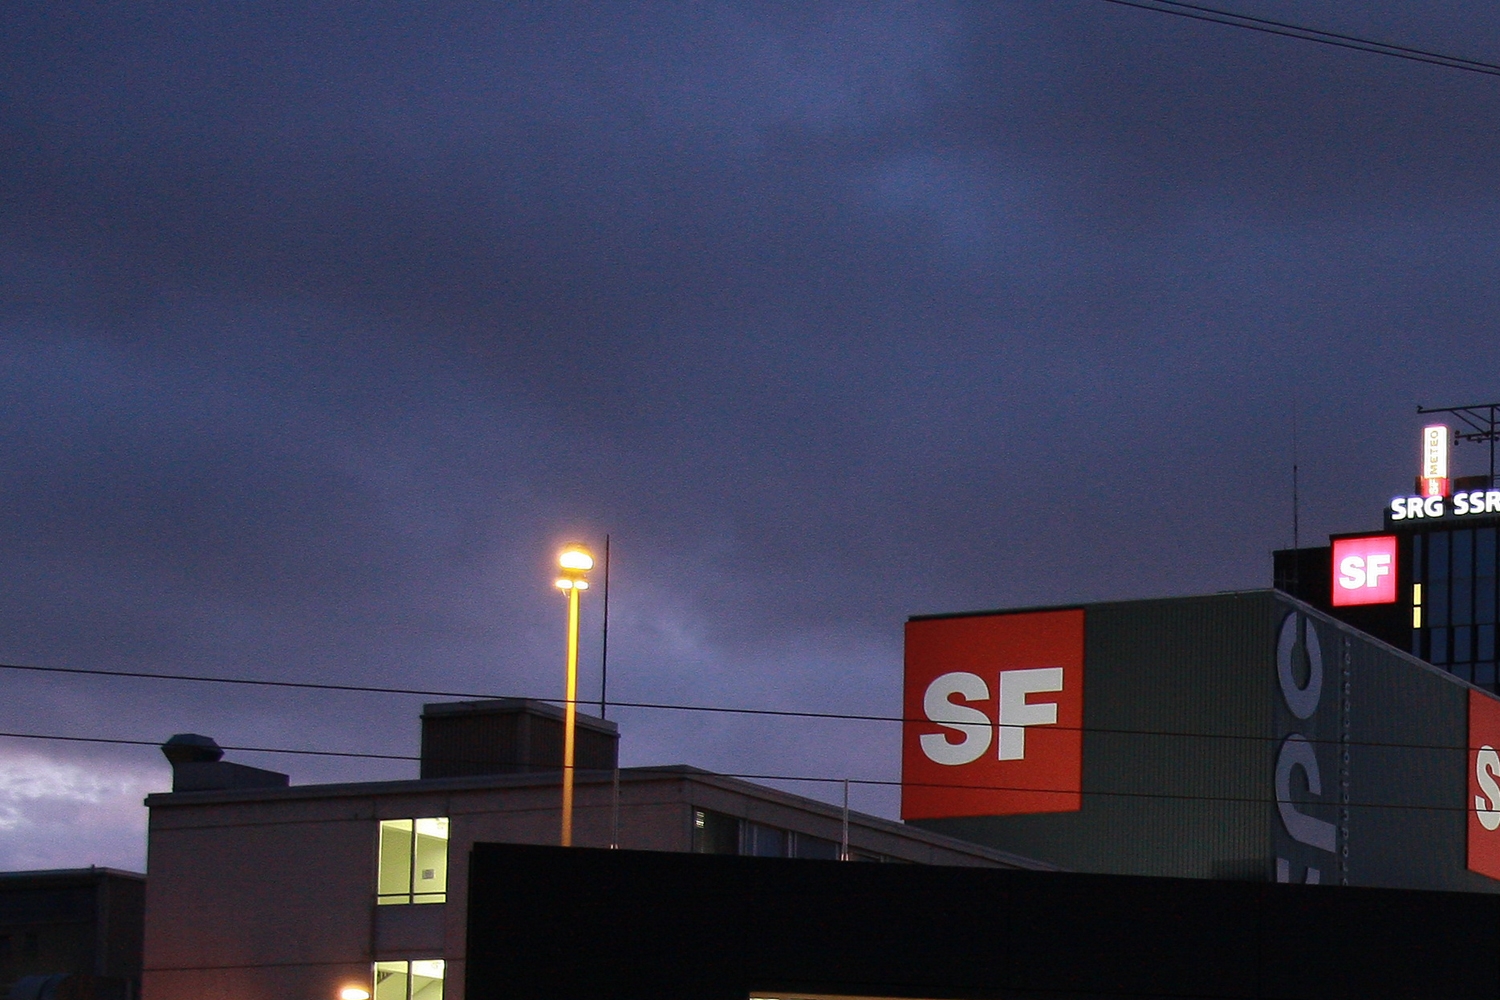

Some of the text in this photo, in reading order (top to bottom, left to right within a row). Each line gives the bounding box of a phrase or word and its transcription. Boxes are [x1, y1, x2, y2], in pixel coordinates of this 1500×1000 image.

[1429, 430, 1439, 475] METEO
[1390, 497, 1443, 520] SRG
[1338, 554, 1391, 590] SF
[919, 667, 1064, 766] SF
